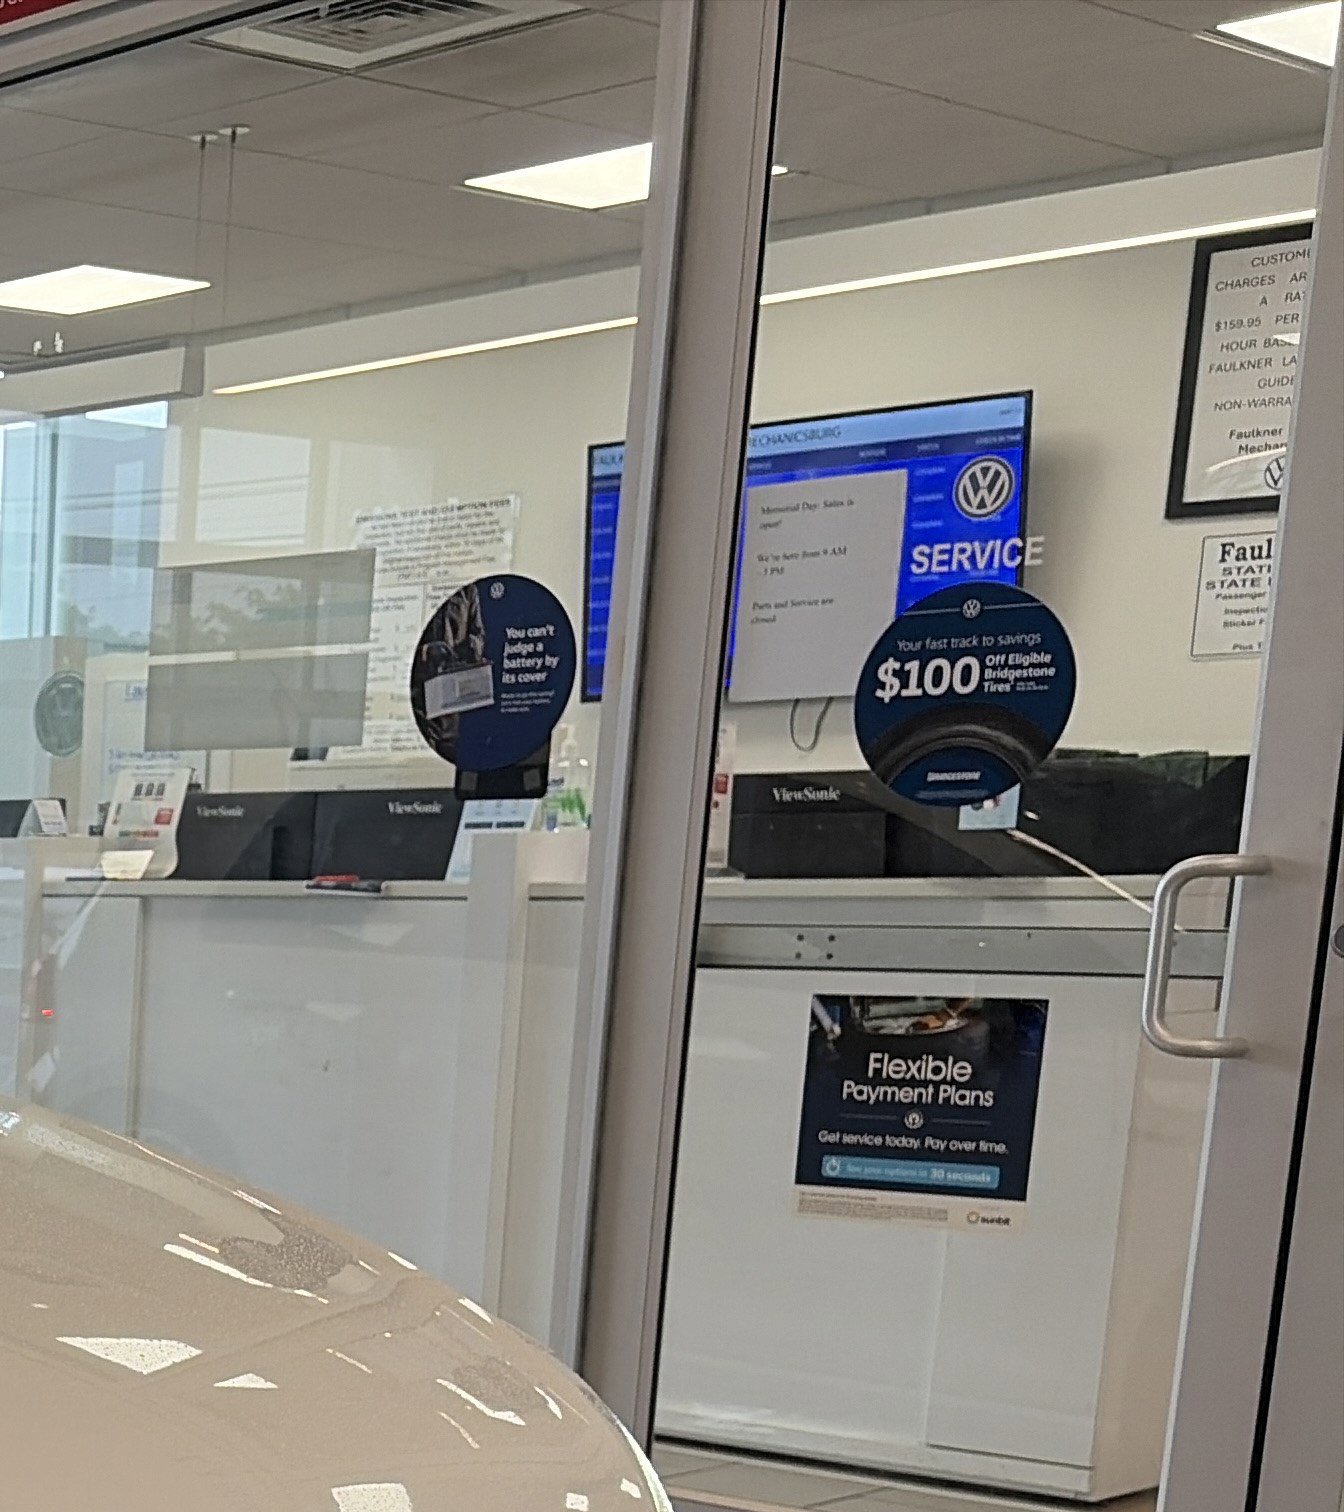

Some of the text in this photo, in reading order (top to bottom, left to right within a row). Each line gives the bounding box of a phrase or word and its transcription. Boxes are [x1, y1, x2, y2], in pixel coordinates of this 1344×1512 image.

[1215, 274, 1276, 292] CHARGES
[1259, 296, 1268, 307] A
[1215, 312, 1300, 332] $159.95 PER
[1220, 339, 1258, 352] HOUR
[1208, 356, 1274, 373] FAULKNER
[1228, 427, 1283, 440] Faulkner
[910, 535, 1045, 575] SERVICE
[1219, 538, 1273, 563] Faul
[1205, 577, 1262, 590] STATE
[506, 624, 555, 639] You can't
[503, 642, 544, 656] judge a
[897, 632, 1042, 652] Your fast track to savings
[503, 654, 560, 670] battery by
[985, 651, 1052, 667] Off Eligible
[502, 671, 548, 684] its cover
[875, 656, 981, 704] $100
[984, 666, 1056, 685] Bridgestone
[772, 785, 841, 802] ViewSonic
[195, 804, 245, 818] ViewSonic
[387, 800, 443, 815] ViewSonic
[867, 1051, 973, 1083] Flexible
[842, 1079, 994, 1107] Payment Plans
[818, 1130, 1009, 1154] Get service today. Pay over time.
[946, 1170, 991, 1183] seconds
